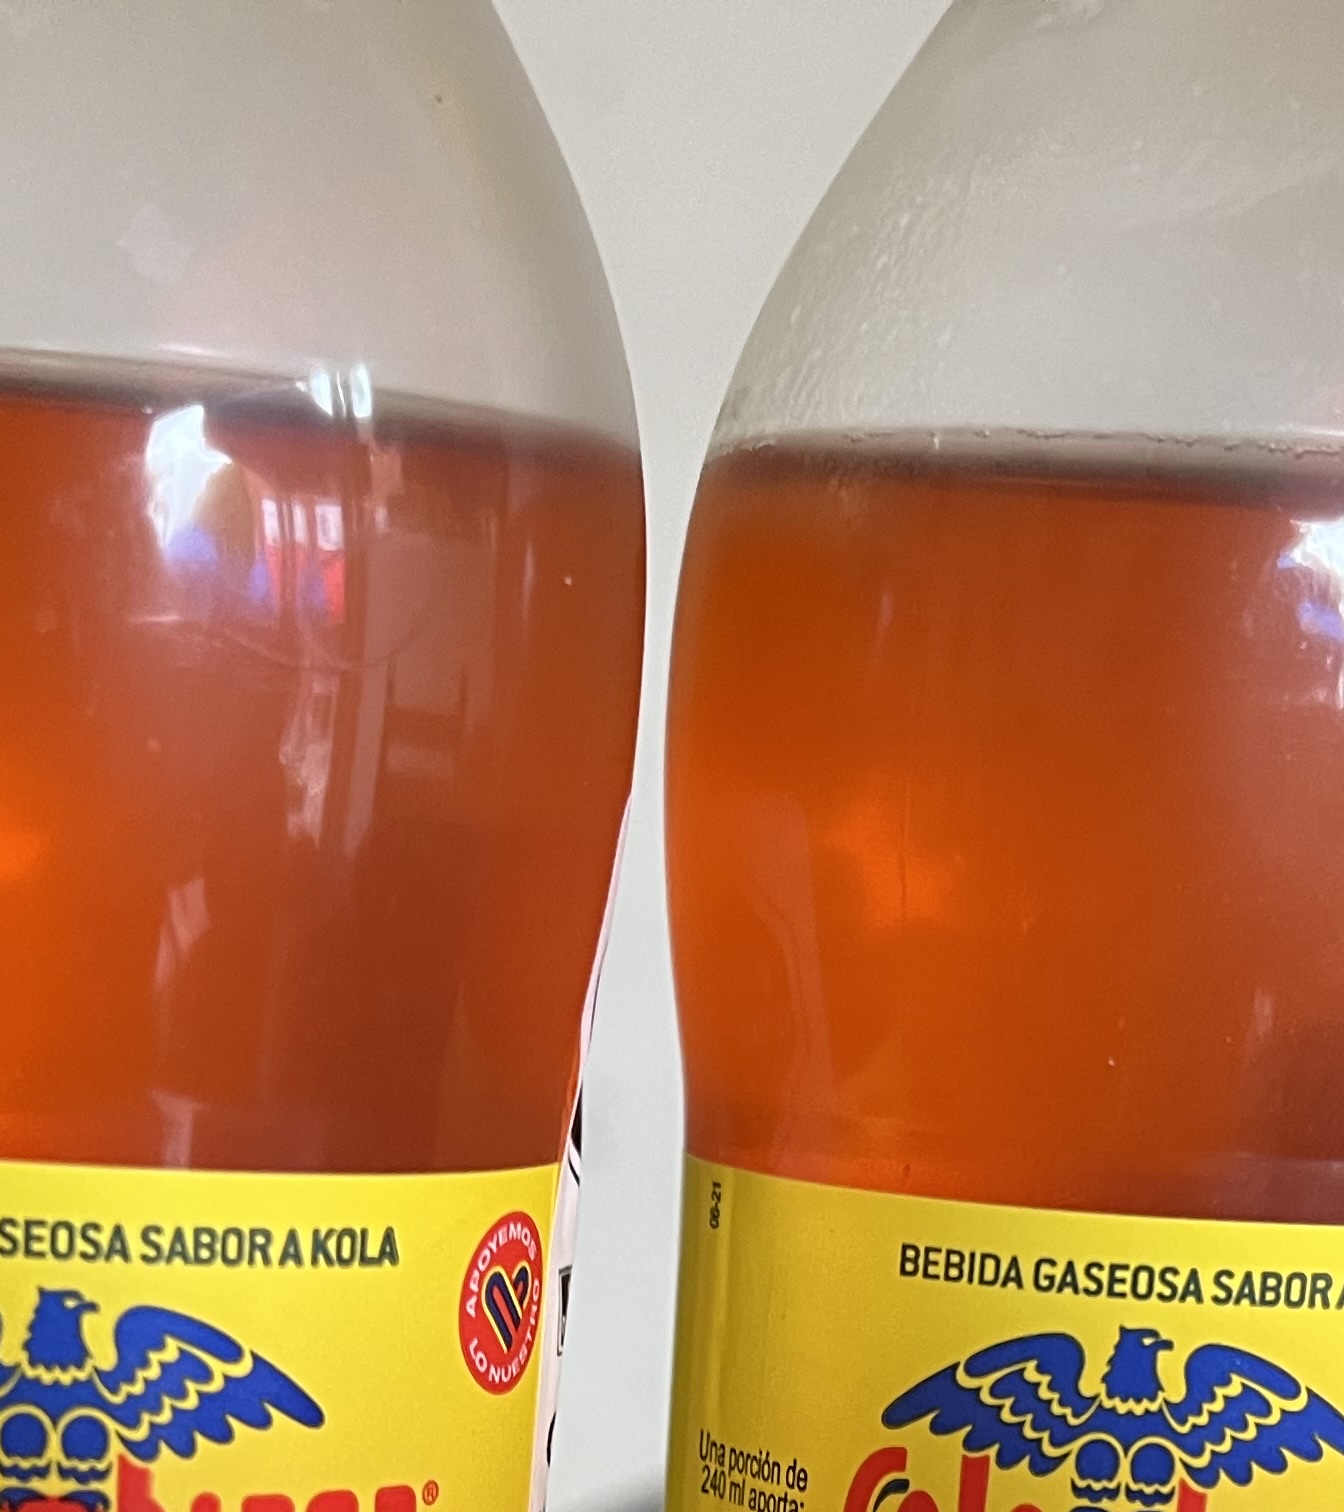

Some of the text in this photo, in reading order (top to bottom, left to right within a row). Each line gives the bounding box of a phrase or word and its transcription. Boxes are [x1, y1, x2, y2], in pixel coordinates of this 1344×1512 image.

[139, 1223, 273, 1268] SABOR
[278, 1228, 305, 1268] A
[310, 1225, 400, 1269] KOLA
[465, 1221, 538, 1319] APOYEMOS
[899, 1241, 1025, 1291] BEBIDA
[1032, 1257, 1205, 1305] GASEOSA
[1210, 1268, 1333, 1311] SABOR
[469, 1337, 488, 1373] LO
[699, 1428, 808, 1493] Una porción de
[701, 1464, 727, 1500] 240
[729, 1477, 746, 1507] ml
